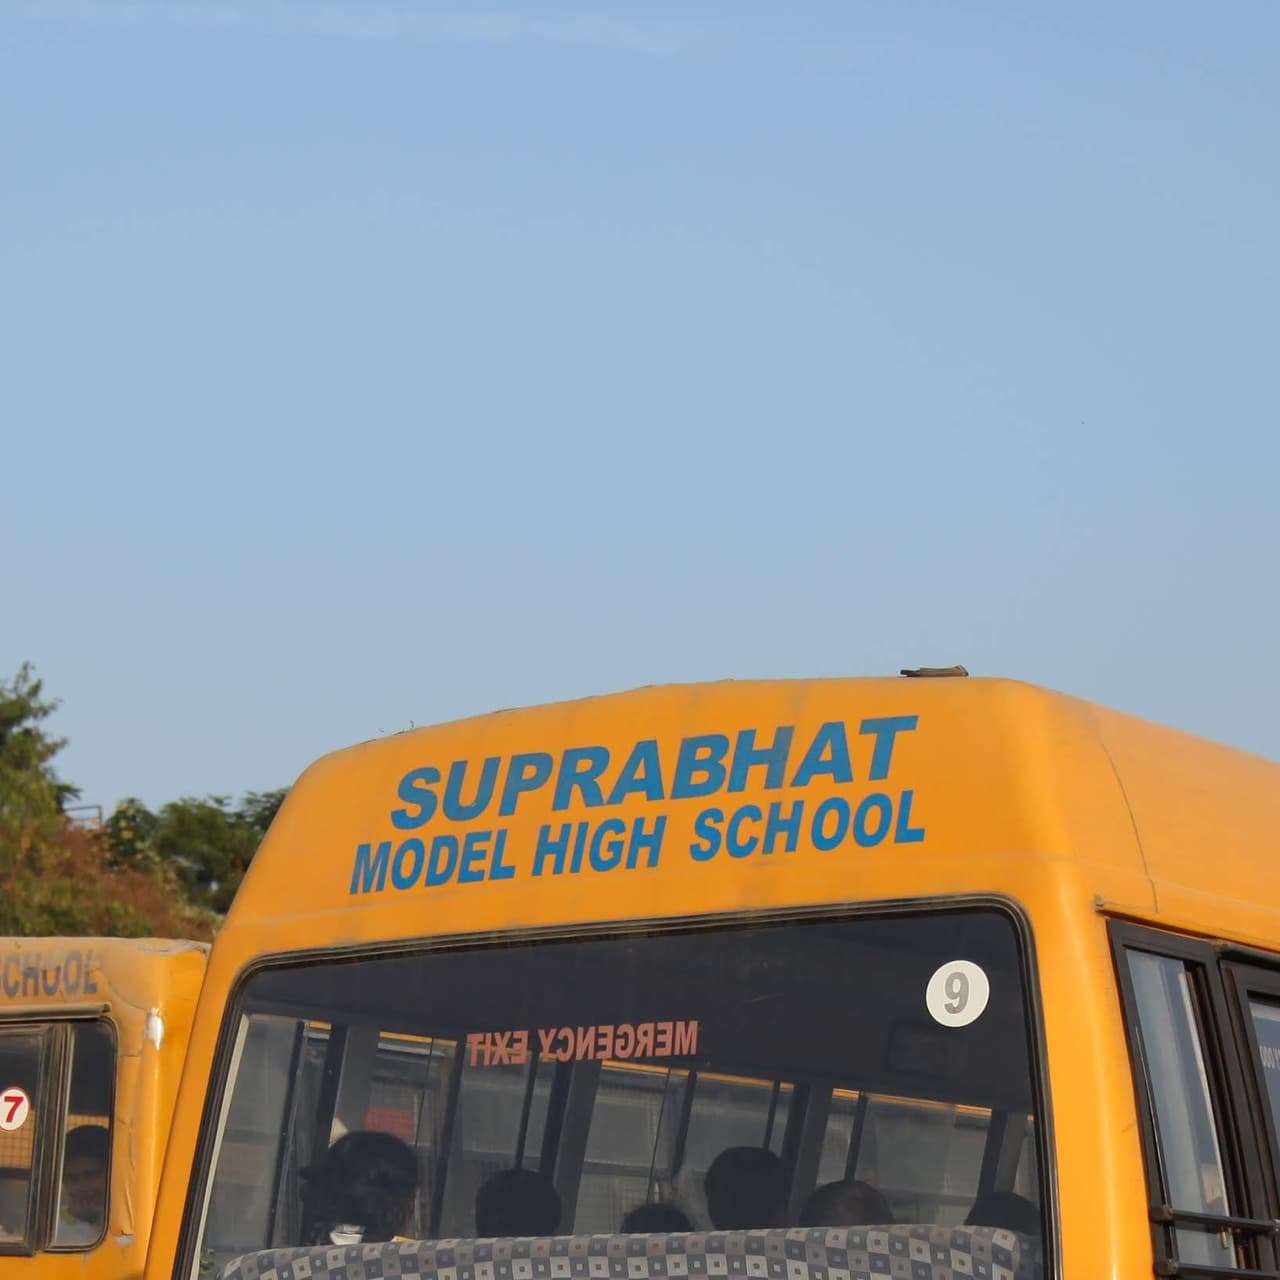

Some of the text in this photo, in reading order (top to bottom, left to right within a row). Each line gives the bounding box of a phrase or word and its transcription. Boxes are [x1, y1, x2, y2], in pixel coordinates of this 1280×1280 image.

[390, 715, 919, 830] SUPRABHAT
[349, 790, 926, 895] MODEL HIGH SCHOOL
[943, 971, 970, 1015] 9
[3, 1096, 24, 1123] 7
